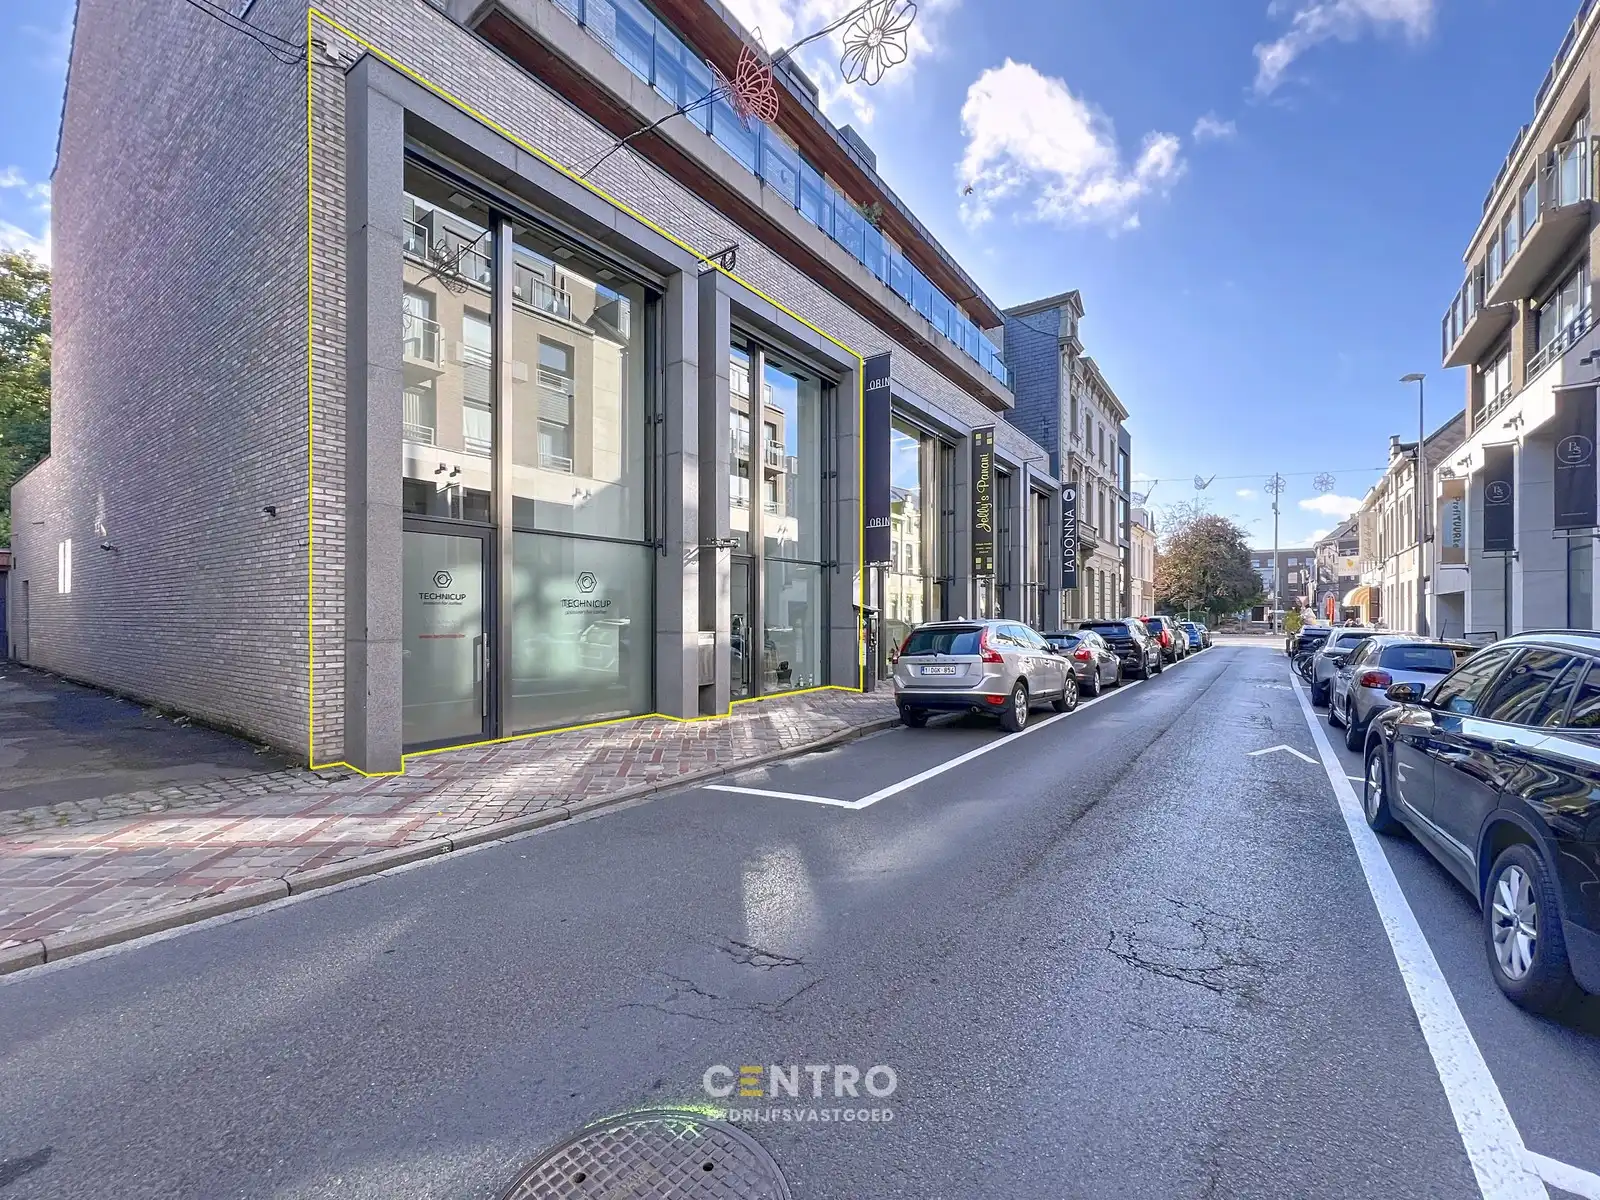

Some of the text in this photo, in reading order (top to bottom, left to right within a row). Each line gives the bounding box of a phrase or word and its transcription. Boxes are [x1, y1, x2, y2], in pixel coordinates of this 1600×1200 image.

[975, 495, 992, 532] Jelly's
[1064, 508, 1075, 573] LA DONNA
[418, 592, 467, 601] TECHNICUP
[559, 599, 612, 608] TECHNICUP
